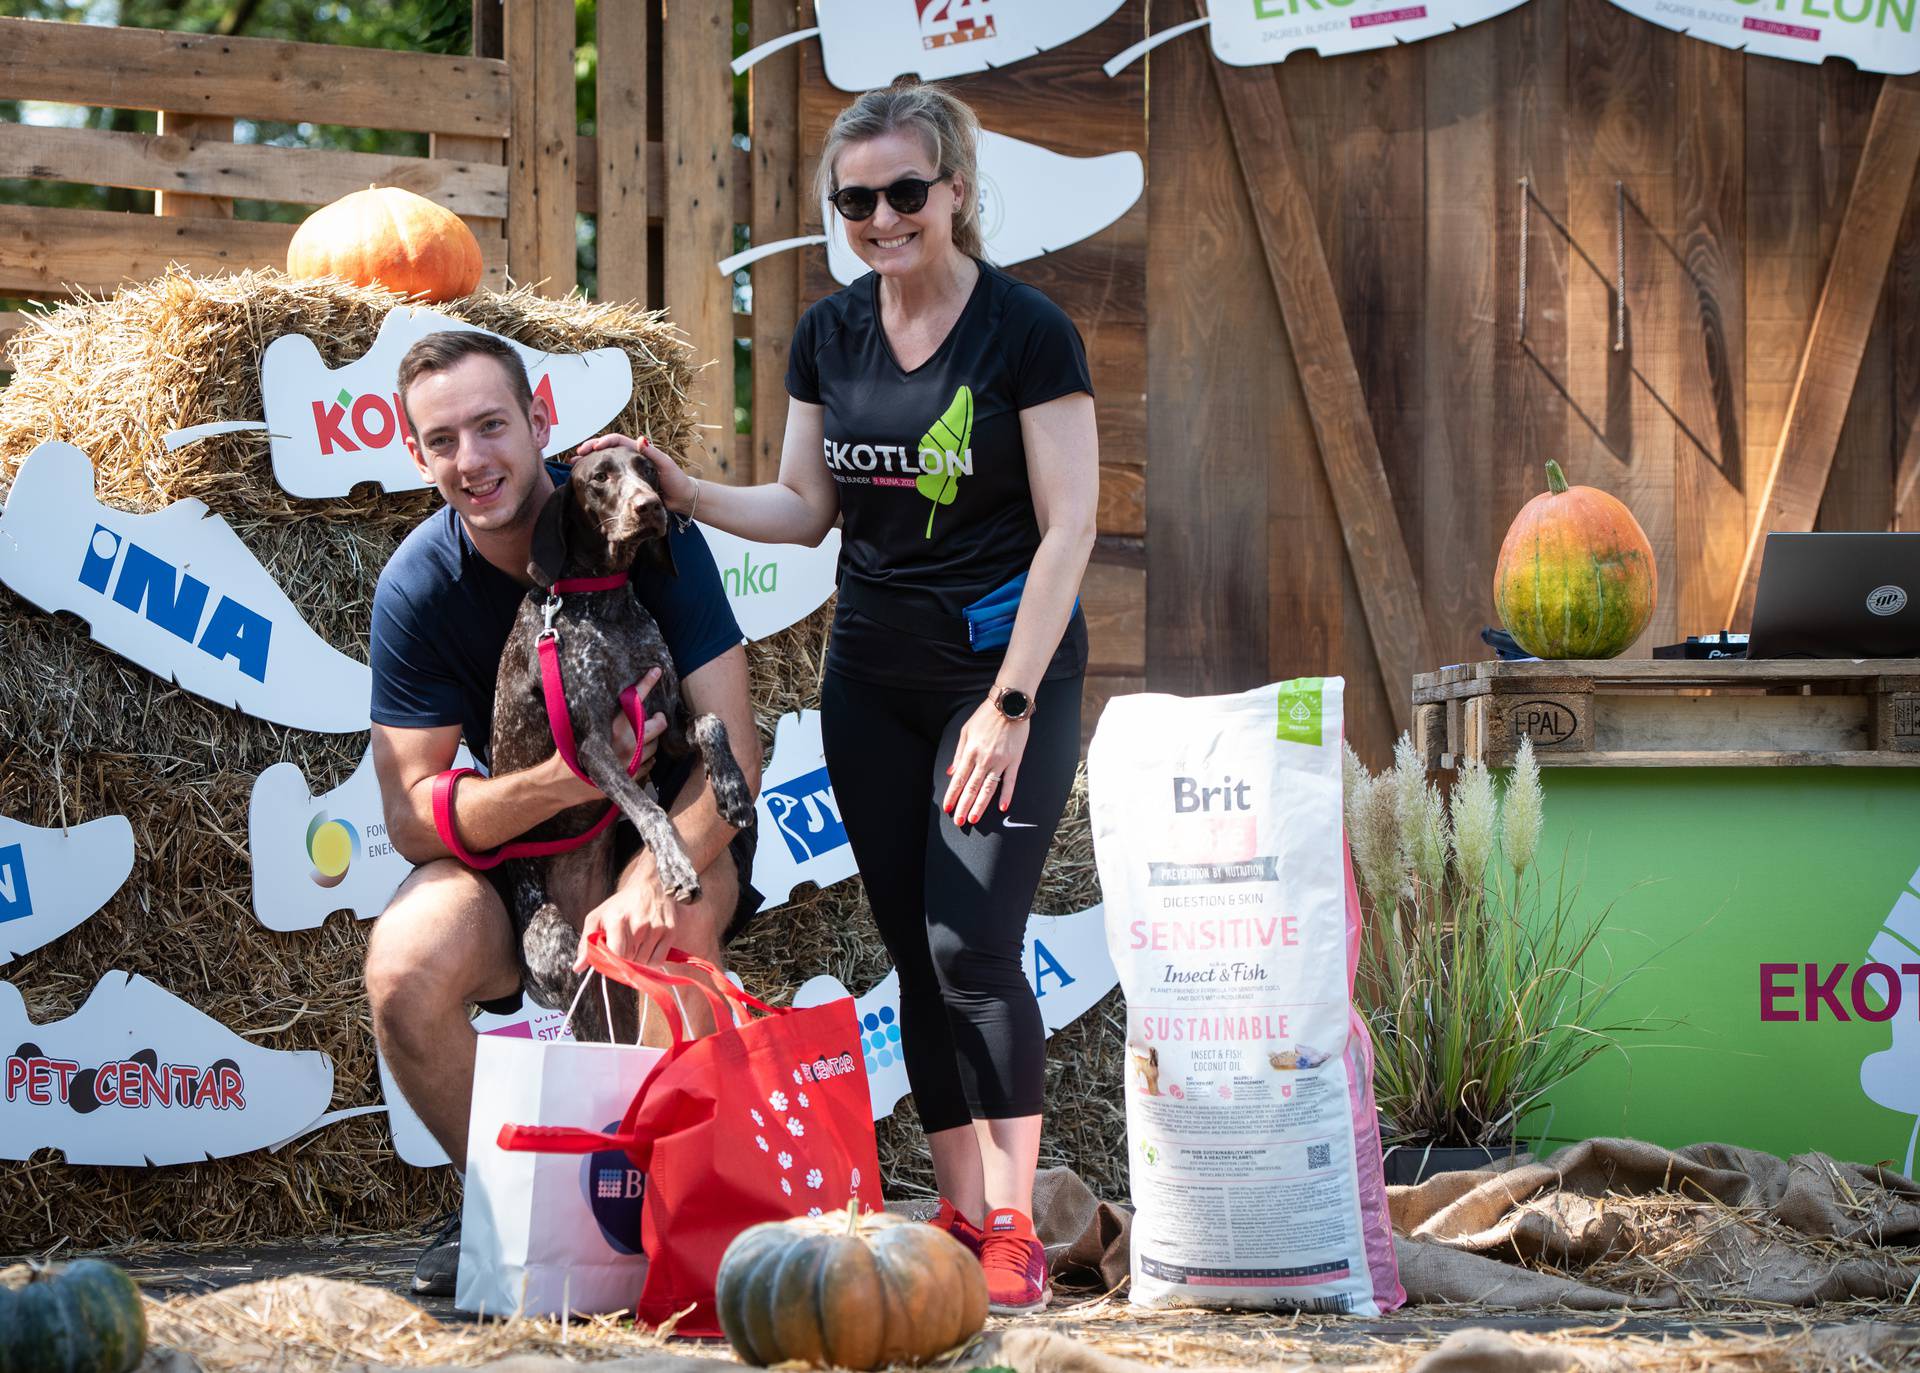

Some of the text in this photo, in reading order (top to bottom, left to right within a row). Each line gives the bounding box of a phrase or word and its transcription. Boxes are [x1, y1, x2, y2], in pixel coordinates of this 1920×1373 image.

[923, 25, 996, 48] SATA
[823, 437, 974, 476] EKOTLON
[1515, 711, 1567, 735] EPAL
[1173, 775, 1251, 813] Brit
[1161, 864, 1264, 881] PREVENTION BY NUTRITION
[1163, 892, 1264, 908] DIGESTION & SKIN
[1130, 916, 1299, 950] SENSITIVE
[1163, 962, 1268, 983] Insect & Fish
[1143, 1015, 1290, 1041] SUSTAINABLE
[1191, 1049, 1242, 1059] INSECT & FISH
[813, 1054, 856, 1081] CENTAR
[1193, 1061, 1241, 1071] COCONUT OIL
[6, 1056, 246, 1110] PET CENTAR
[993, 1214, 1015, 1225] NIKE
